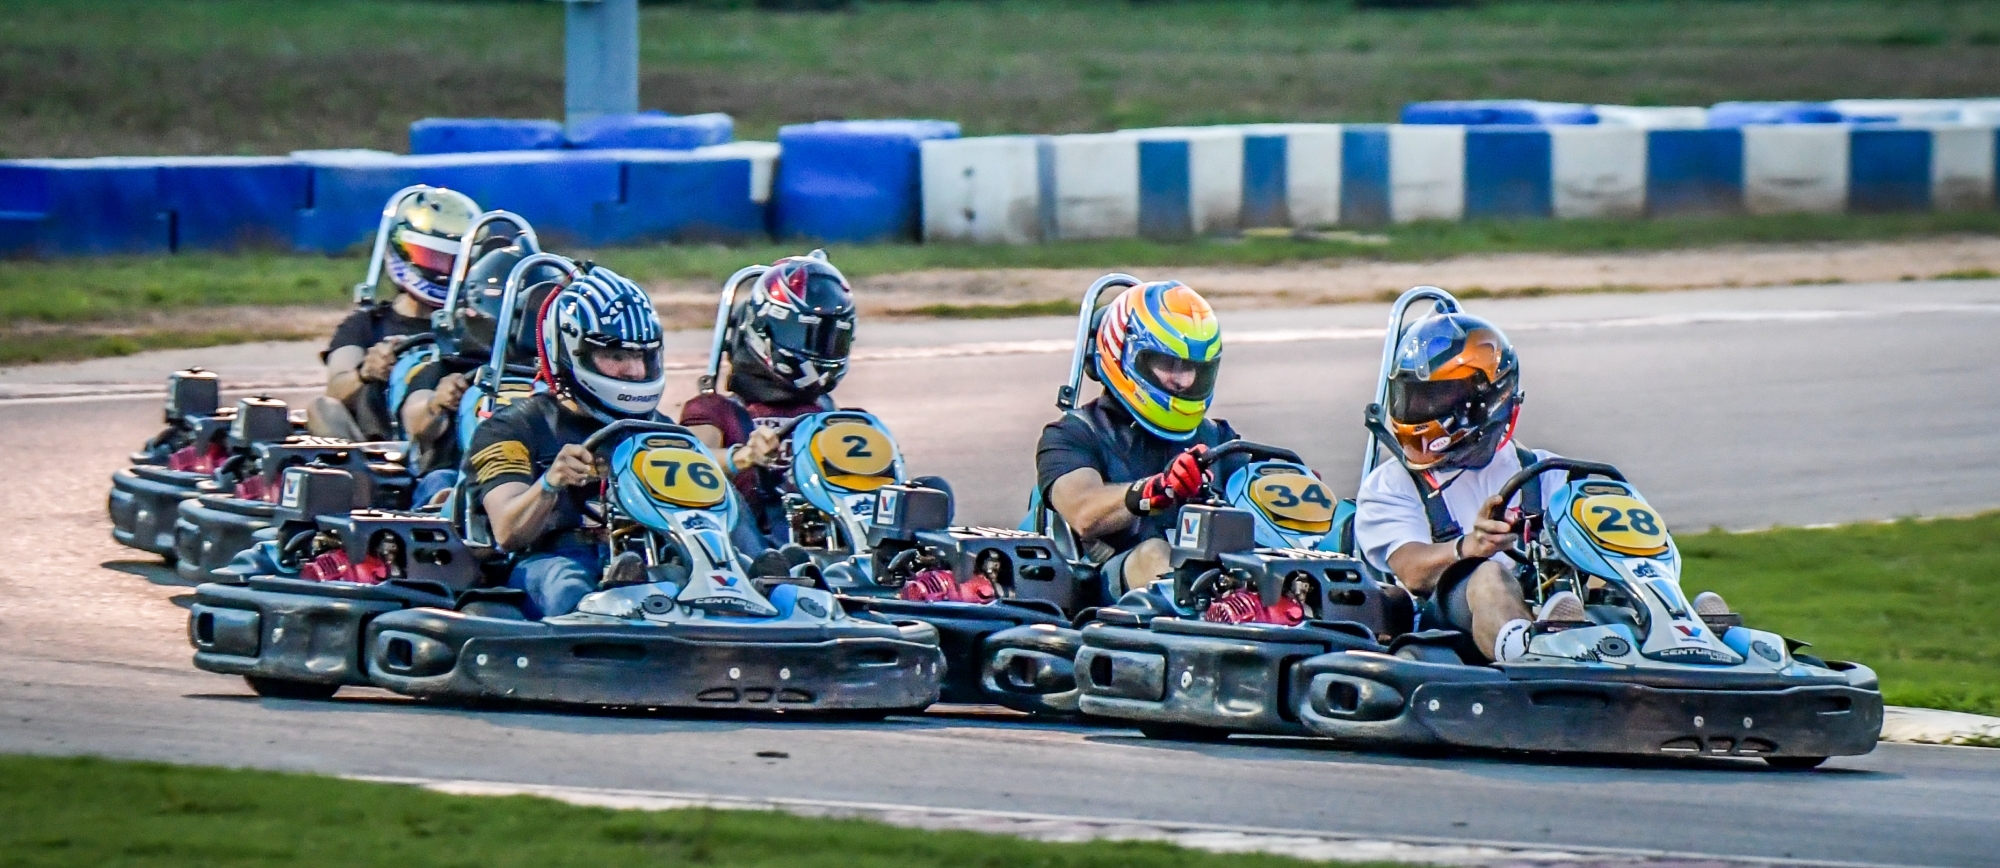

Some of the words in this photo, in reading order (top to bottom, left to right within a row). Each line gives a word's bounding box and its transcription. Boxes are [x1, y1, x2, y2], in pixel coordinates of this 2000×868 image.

[842, 435, 872, 457] 2
[650, 460, 719, 490] 76
[1264, 484, 1332, 509] 34
[1591, 506, 1660, 536] 28
